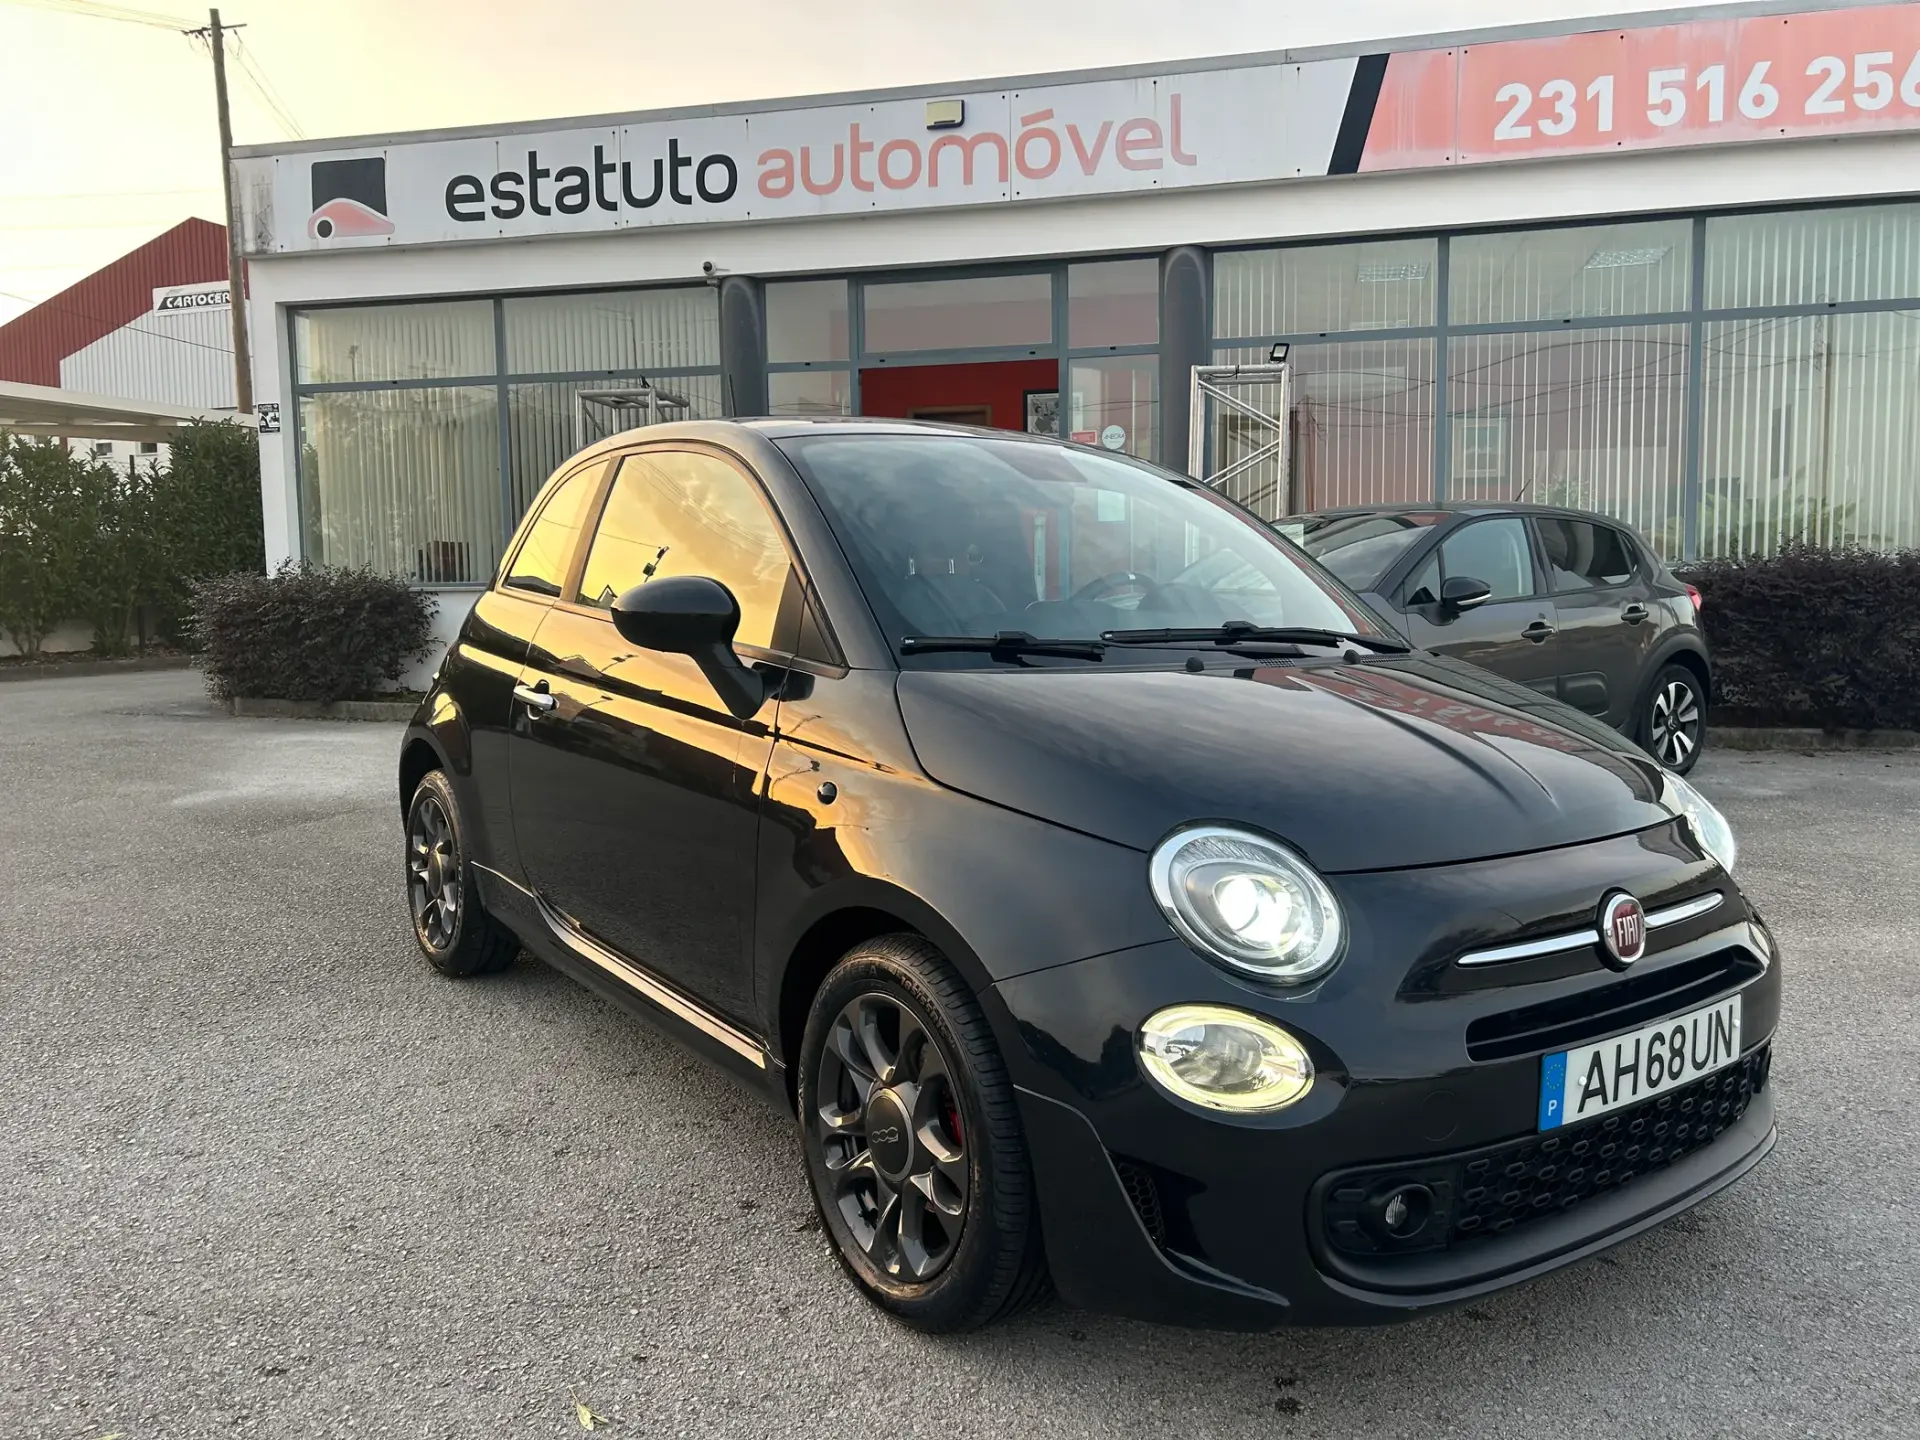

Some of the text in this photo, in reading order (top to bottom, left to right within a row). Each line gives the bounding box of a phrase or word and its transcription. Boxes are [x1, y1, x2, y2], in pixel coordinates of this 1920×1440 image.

[1494, 76, 1614, 140] 231
[1647, 62, 1779, 127] 516
[446, 94, 1197, 222] estatuto automóvel
[1616, 914, 1640, 947] FIAT
[1547, 1100, 1557, 1117] P
